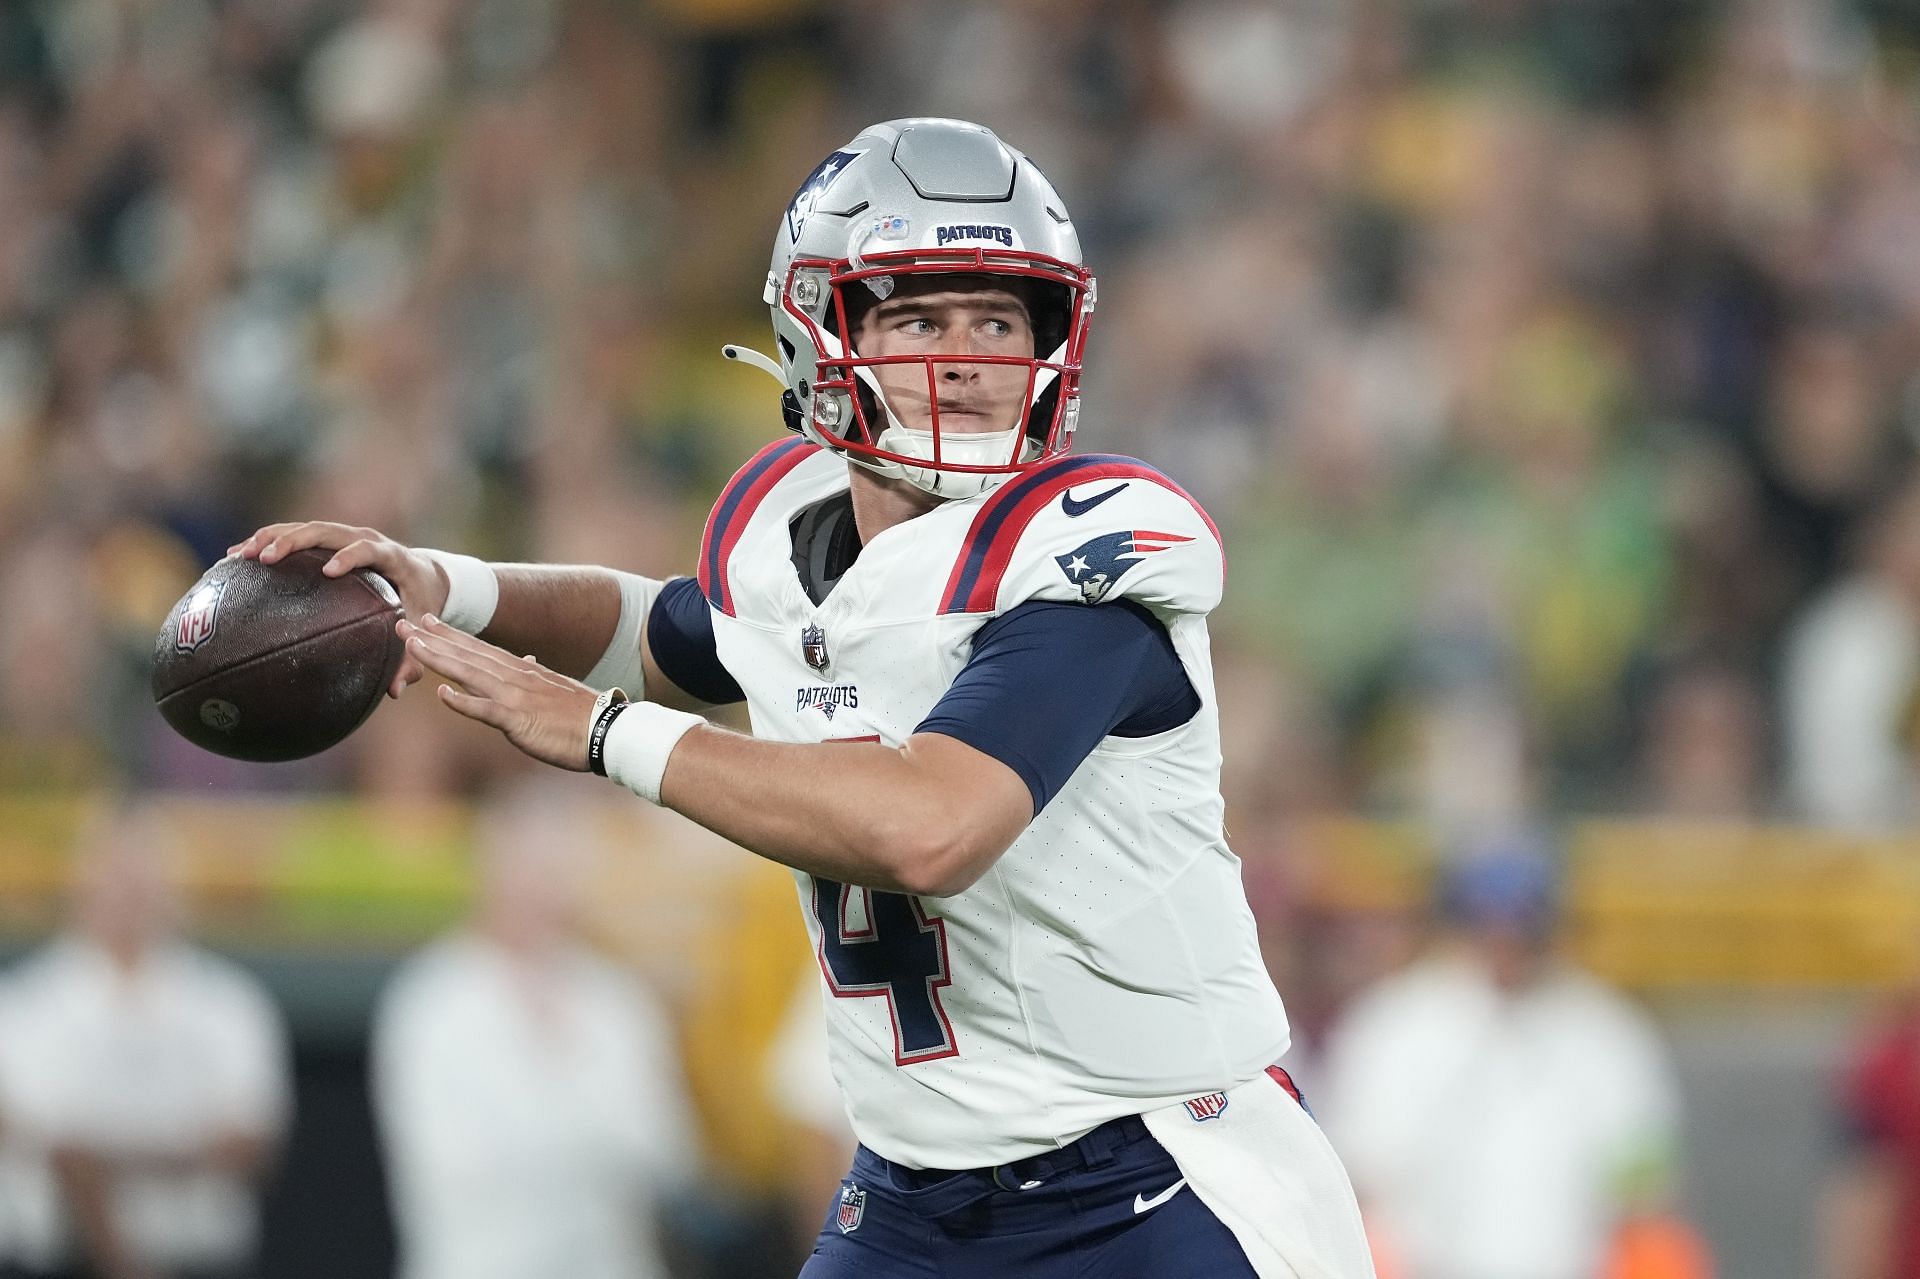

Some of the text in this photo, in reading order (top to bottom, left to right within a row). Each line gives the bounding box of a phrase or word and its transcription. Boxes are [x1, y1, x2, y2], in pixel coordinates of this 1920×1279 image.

[936, 225, 1013, 247] PATRIOTS
[179, 610, 211, 644] NFL
[796, 685, 858, 713] PATRIOTS
[811, 735, 960, 1067] 4
[1187, 1093, 1225, 1118] NFL
[840, 1205, 857, 1225] NFL
